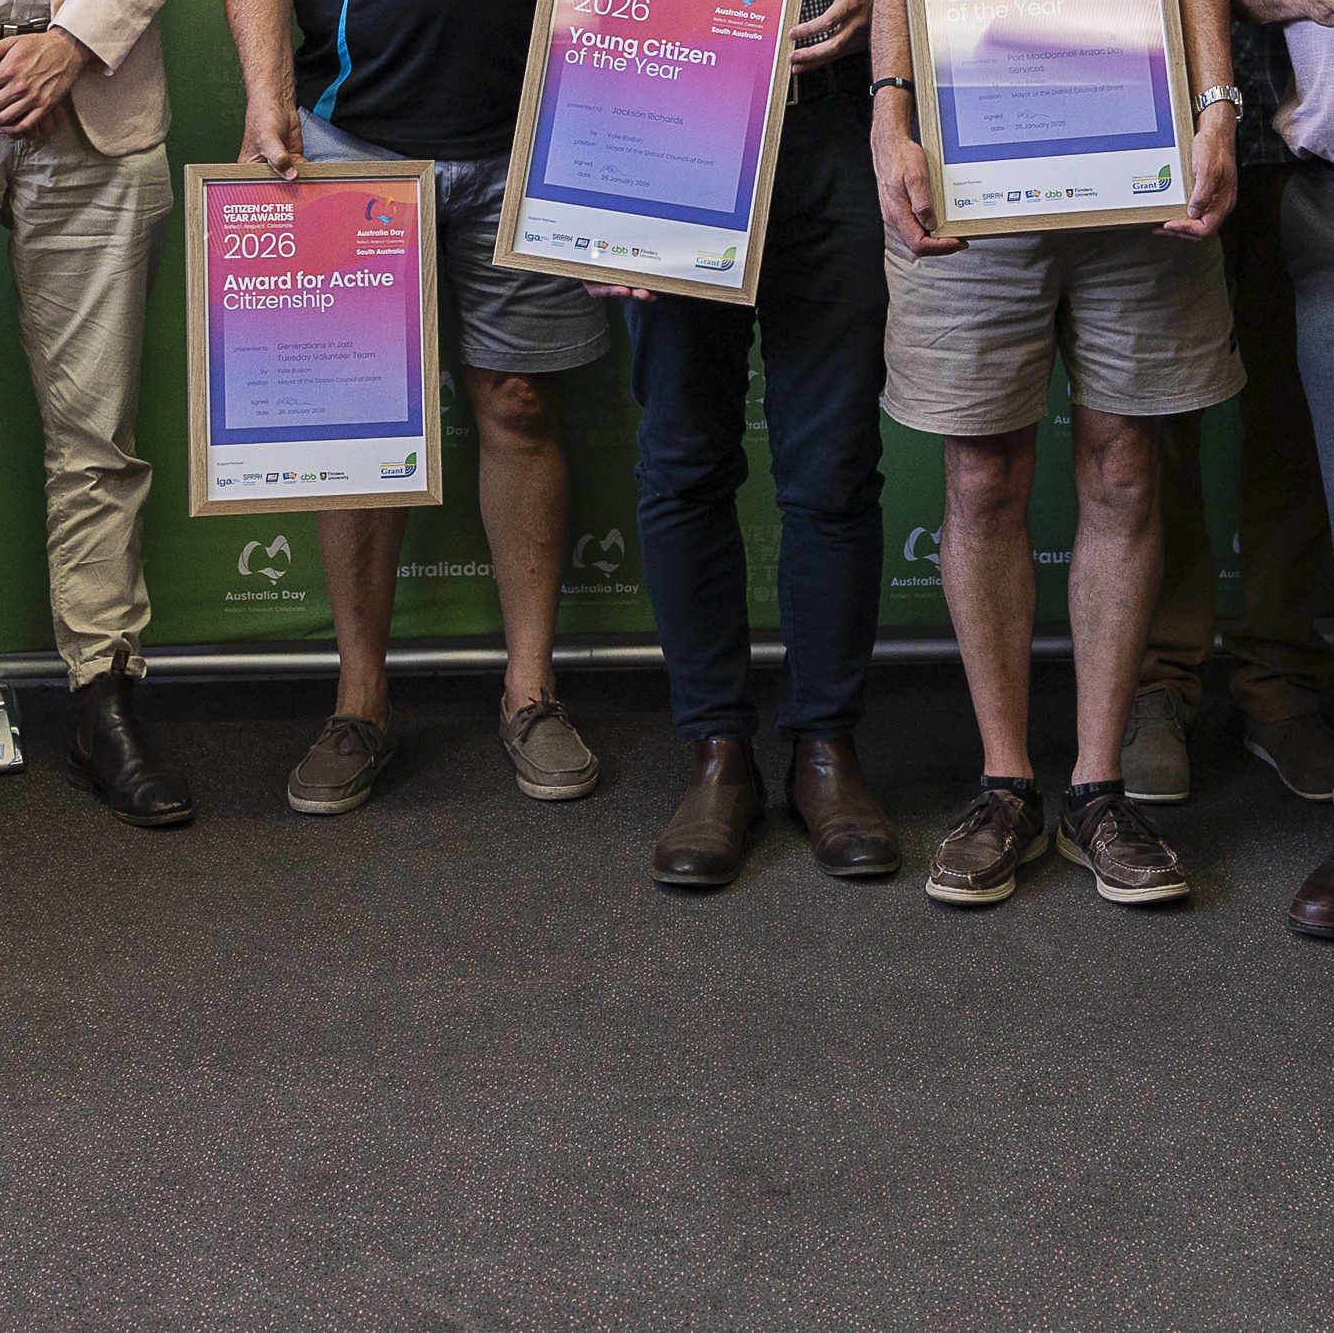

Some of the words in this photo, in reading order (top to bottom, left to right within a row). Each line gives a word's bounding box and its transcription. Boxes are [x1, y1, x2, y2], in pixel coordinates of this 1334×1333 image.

[715, 6, 749, 19] Australia
[749, 12, 766, 22] Day
[947, 4, 968, 22] of
[973, 2, 1009, 20] the
[1014, 0, 1064, 17] Year
[711, 26, 731, 36] South
[731, 29, 763, 41] Australia
[569, 26, 639, 59] Young
[643, 39, 717, 66] Citizen
[1008, 54, 1025, 62] Port
[1026, 50, 1077, 61] MacDonnell
[1079, 48, 1105, 57] Anzac
[1107, 47, 1124, 56] Day
[565, 47, 588, 65] of
[592, 51, 627, 72] the
[635, 57, 682, 80] Year
[1009, 65, 1045, 74] Services
[612, 107, 646, 120] Jackson
[647, 112, 684, 125] Richards
[1024, 122, 1050, 130] January
[609, 175, 634, 186] January
[1132, 182, 1157, 190] Grant
[223, 204, 261, 214] CITIZEN
[261, 204, 272, 213] OF
[272, 203, 294, 213] THE
[223, 214, 249, 223] YEAR
[250, 213, 294, 223] AWARDS
[390, 229, 405, 237] Day
[223, 232, 296, 259] 2026
[696, 257, 721, 267] Grant
[223, 272, 292, 291] Award
[296, 271, 325, 289] for
[329, 269, 394, 288] Active
[223, 290, 335, 313] Citizenship
[277, 342, 326, 351] Generations
[328, 341, 335, 349] in
[277, 354, 311, 363] Tuesday
[225, 589, 278, 602] Australia
[282, 588, 306, 604] Day
[561, 583, 611, 595] Australia
[615, 582, 639, 598] Day
